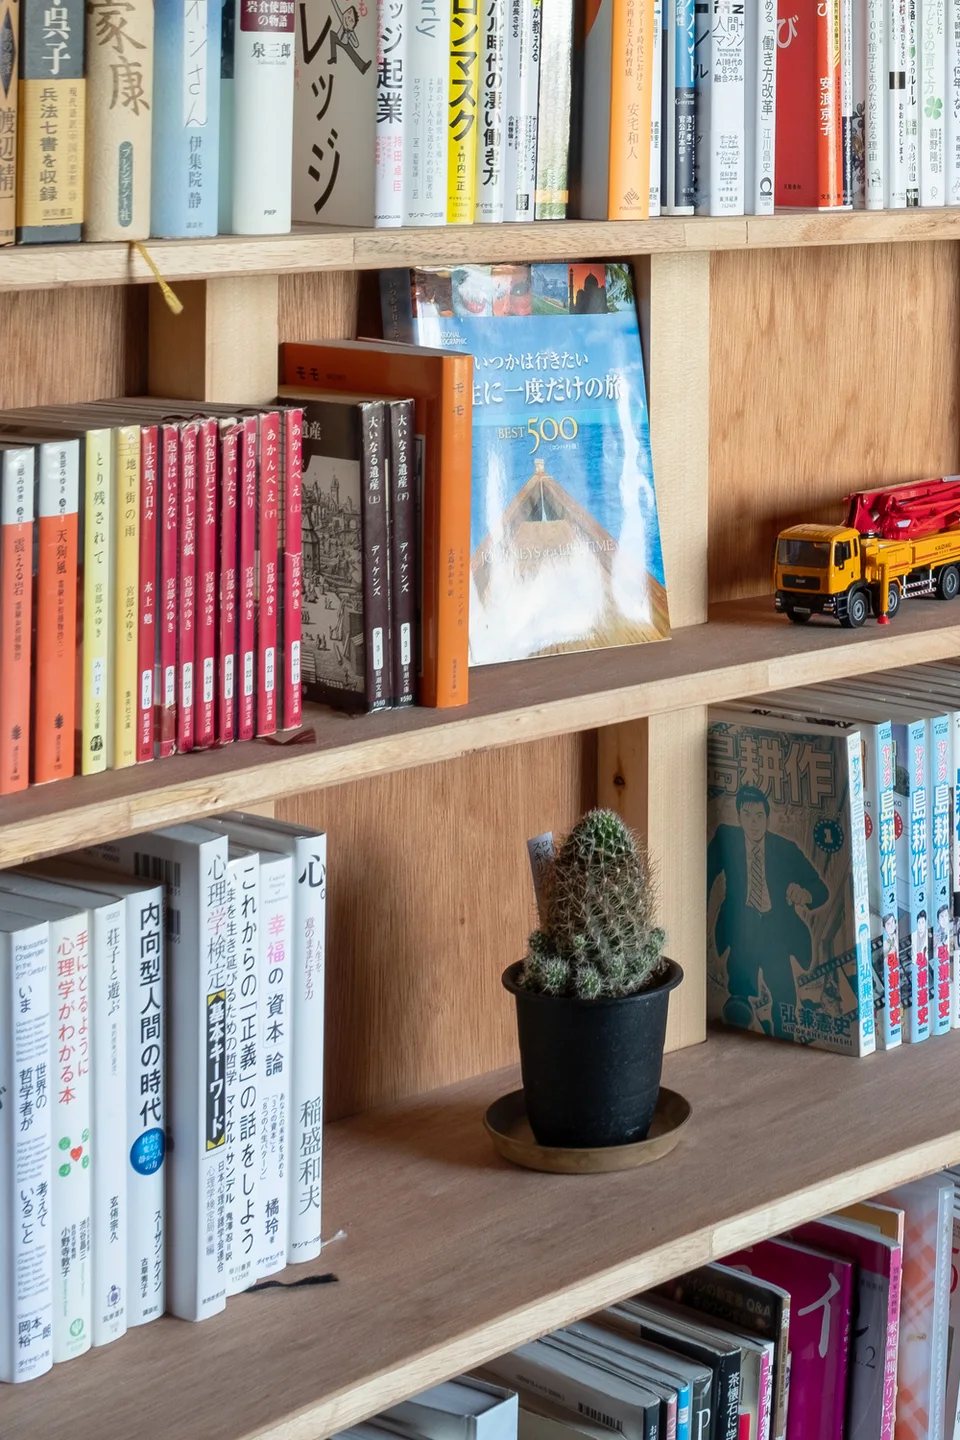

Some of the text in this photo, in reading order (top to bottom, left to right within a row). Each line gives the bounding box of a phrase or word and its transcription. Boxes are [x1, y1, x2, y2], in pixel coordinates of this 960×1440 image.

[246, 0, 295, 15] 岩倉使節団
[258, 14, 288, 28] の物語
[714, 74, 744, 82] 融合スキル
[715, 58, 743, 67] AI時代の
[39, 87, 59, 203] 兵法七書を収録
[762, 128, 771, 174] 江川昌史
[930, 128, 939, 174] 前野隆司
[453, 381, 465, 417] モモ
[474, 352, 589, 372] いつかは行きたい
[265, 428, 277, 503] あかんべえ
[498, 417, 579, 455] BEST 500
[124, 459, 137, 538] 地下街の雨
[143, 441, 155, 522] 土を喰う日々
[183, 435, 195, 557] 本所深川ふしぎ草紙
[204, 434, 216, 527] 幻色江戸ごよみ
[367, 415, 381, 597] 大いなる遺産 ディケンズ
[56, 529, 68, 575] 天狗風
[92, 452, 105, 640] とり残されて 宮部みゆき
[165, 440, 177, 633] 返事はいらない 宮部みゆき
[888, 893, 896, 903] 2
[19, 984, 32, 1013] いま
[76, 930, 89, 1077] 手にとるように
[107, 927, 120, 1016] 荘子と遊ぶ
[207, 854, 227, 1140] 心理学検定 基本キーワード
[265, 912, 285, 1076] 幸福の資本論
[57, 937, 76, 1105] 心理学がわかる本
[138, 901, 163, 1128] 内向型人間の時代
[35, 1062, 47, 1109] 世界の
[238, 864, 257, 1255] これからの「正義」の話をしよう
[19, 1067, 34, 1132] 哲学者が
[299, 1096, 320, 1215] 稲盛和夫
[20, 1186, 34, 1244] いること
[37, 1181, 48, 1227] 考えて
[153, 1210, 163, 1292] スーザン・ケイン
[883, 1321, 898, 1432] 家庭画報デリシャス
